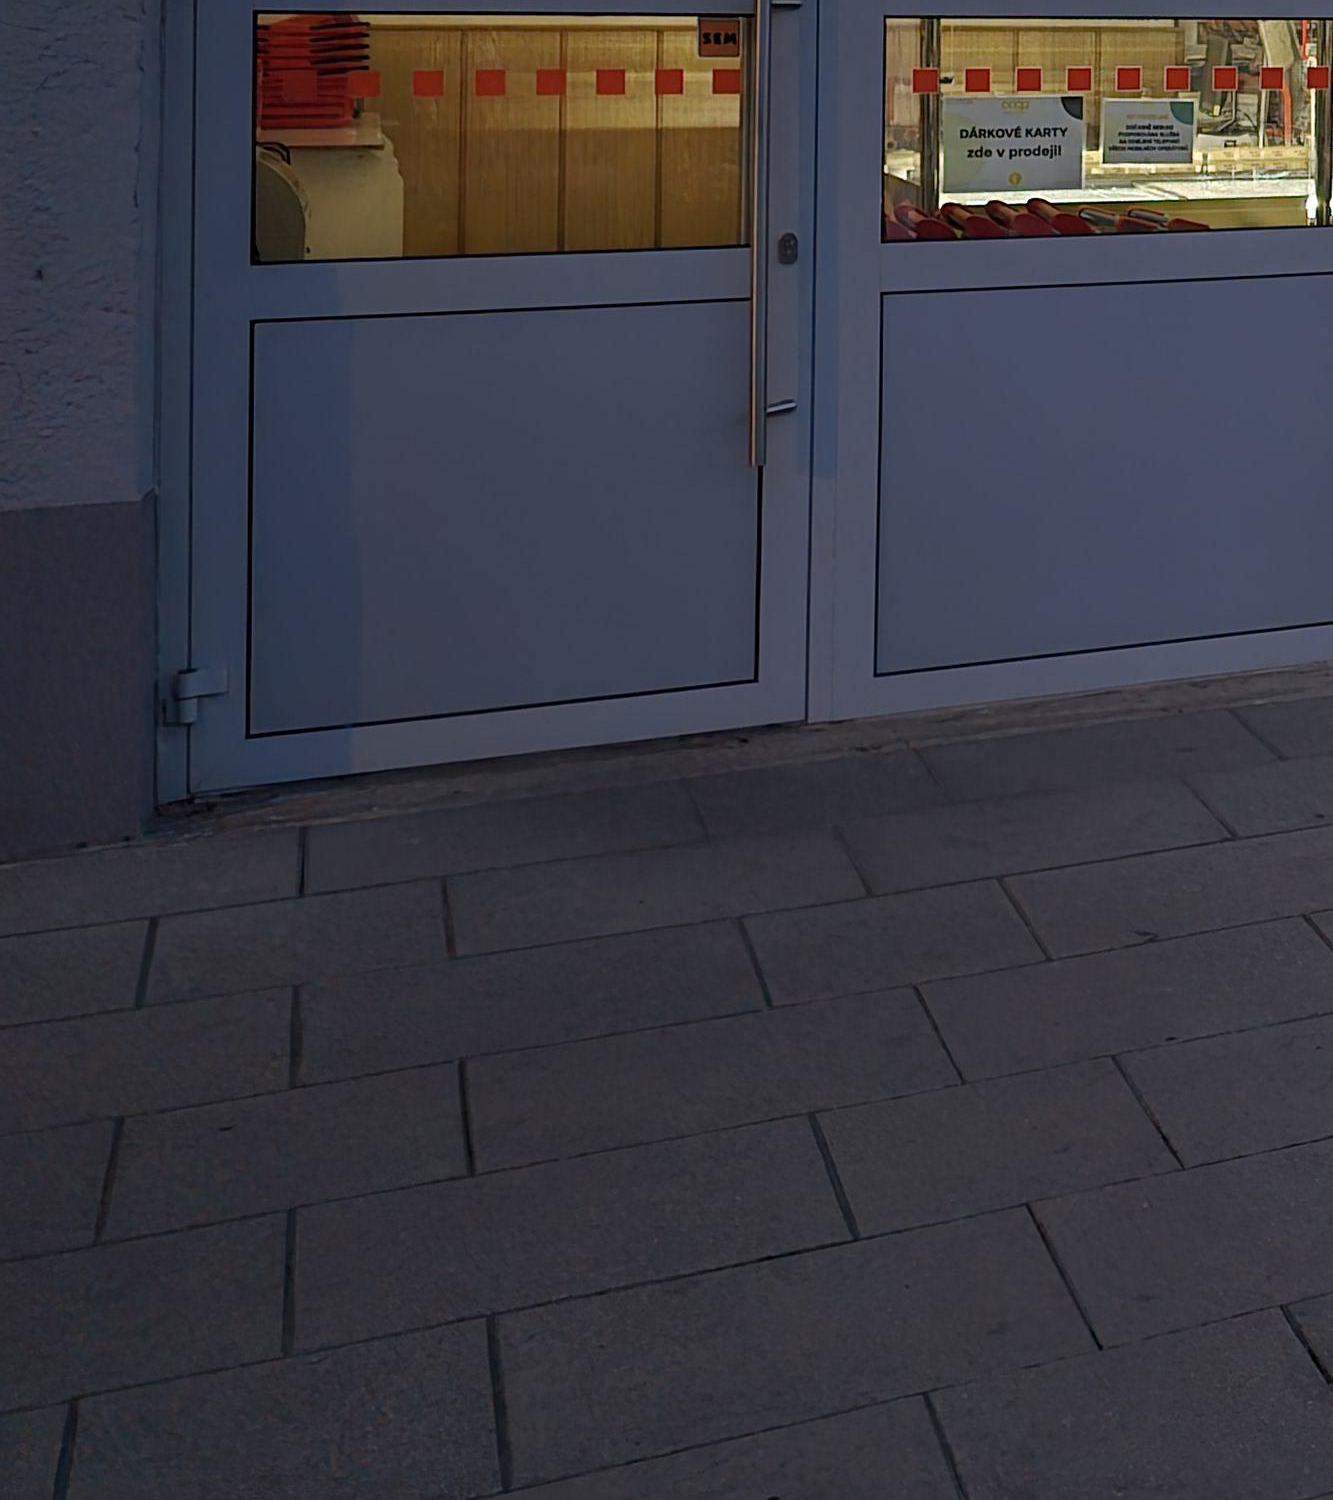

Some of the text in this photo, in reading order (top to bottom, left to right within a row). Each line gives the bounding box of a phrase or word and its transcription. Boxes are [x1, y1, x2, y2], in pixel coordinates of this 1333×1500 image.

[960, 125, 1068, 139] DÁRKOVÉ KARTY
[967, 146, 993, 158] zde
[996, 149, 1006, 158] v
